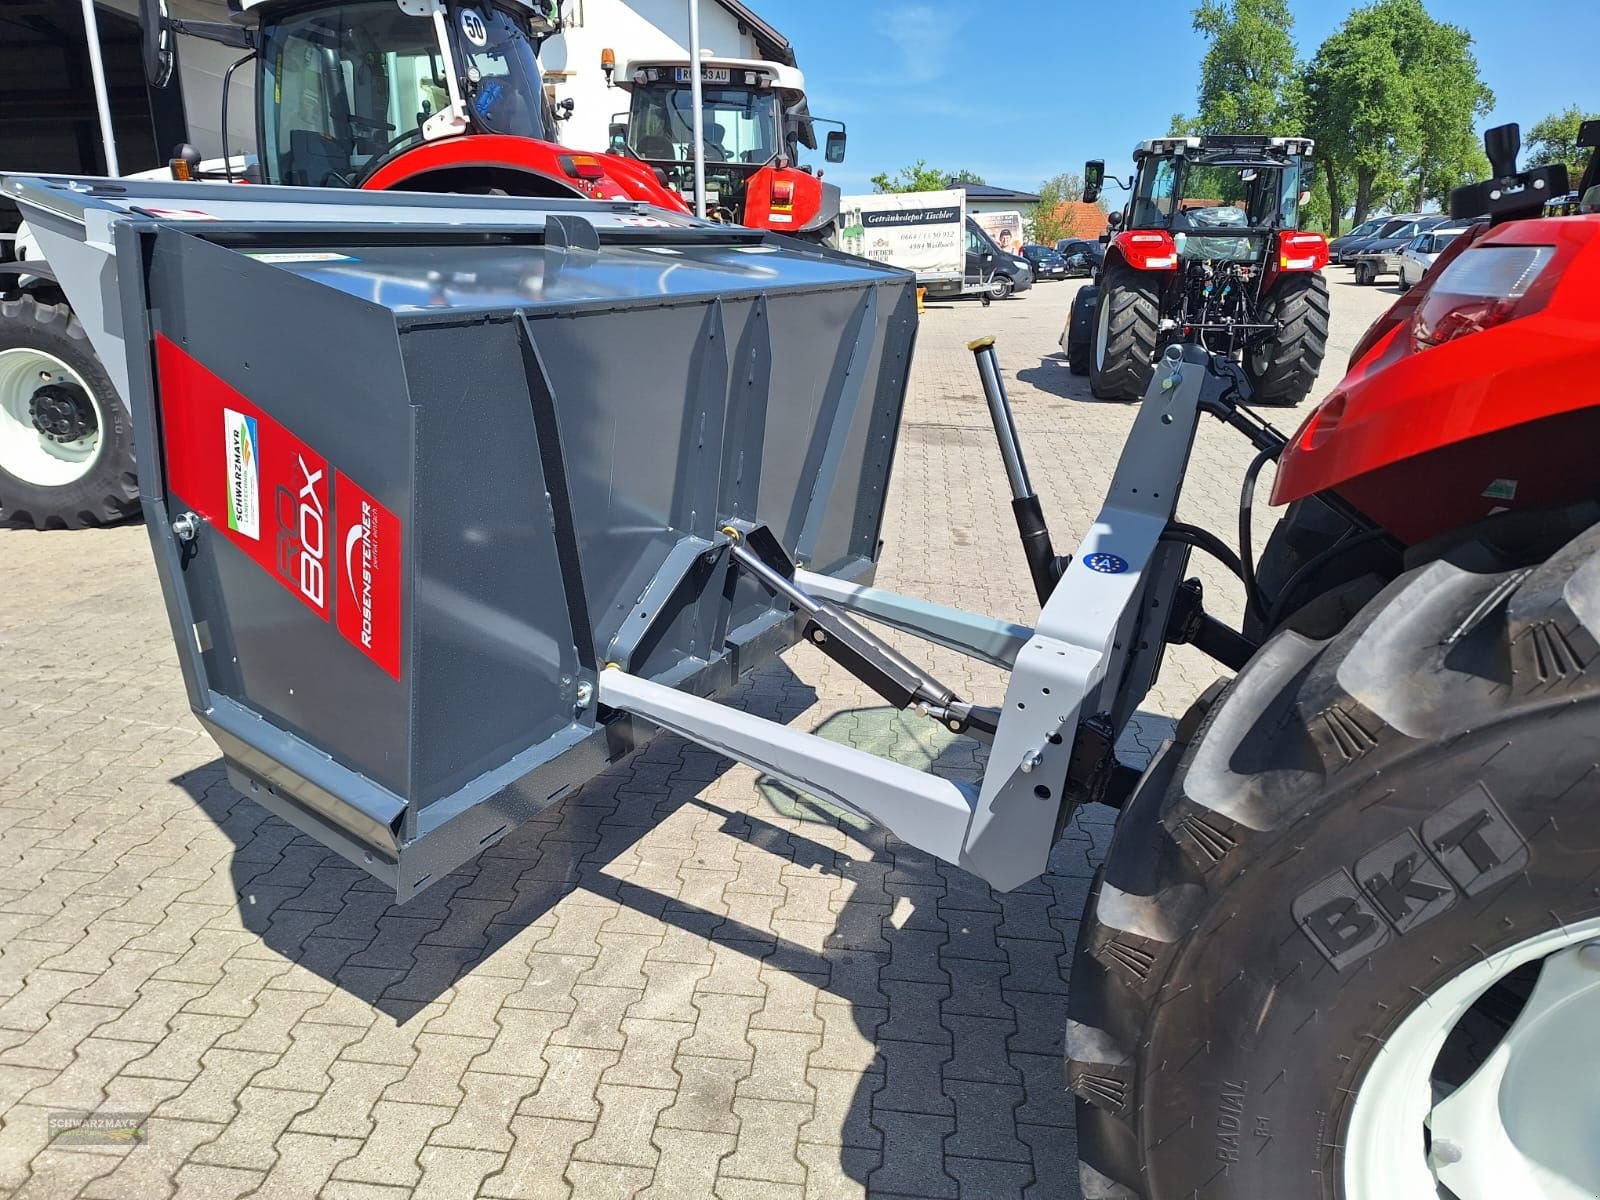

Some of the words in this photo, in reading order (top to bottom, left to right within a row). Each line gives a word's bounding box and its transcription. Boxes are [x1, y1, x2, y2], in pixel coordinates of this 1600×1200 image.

[463, 15, 484, 39] 50
[715, 70, 727, 80] AU
[868, 212, 923, 223] Getränkedepot
[925, 210, 954, 220] Tischler
[868, 249, 894, 257] RIEDER
[234, 429, 243, 522] SCHWARZMAYR
[299, 453, 323, 608] BOX
[361, 501, 372, 648] ROSENSTEINER
[1303, 807, 1501, 960] BKT
[1216, 1080, 1248, 1162] RADIAL
